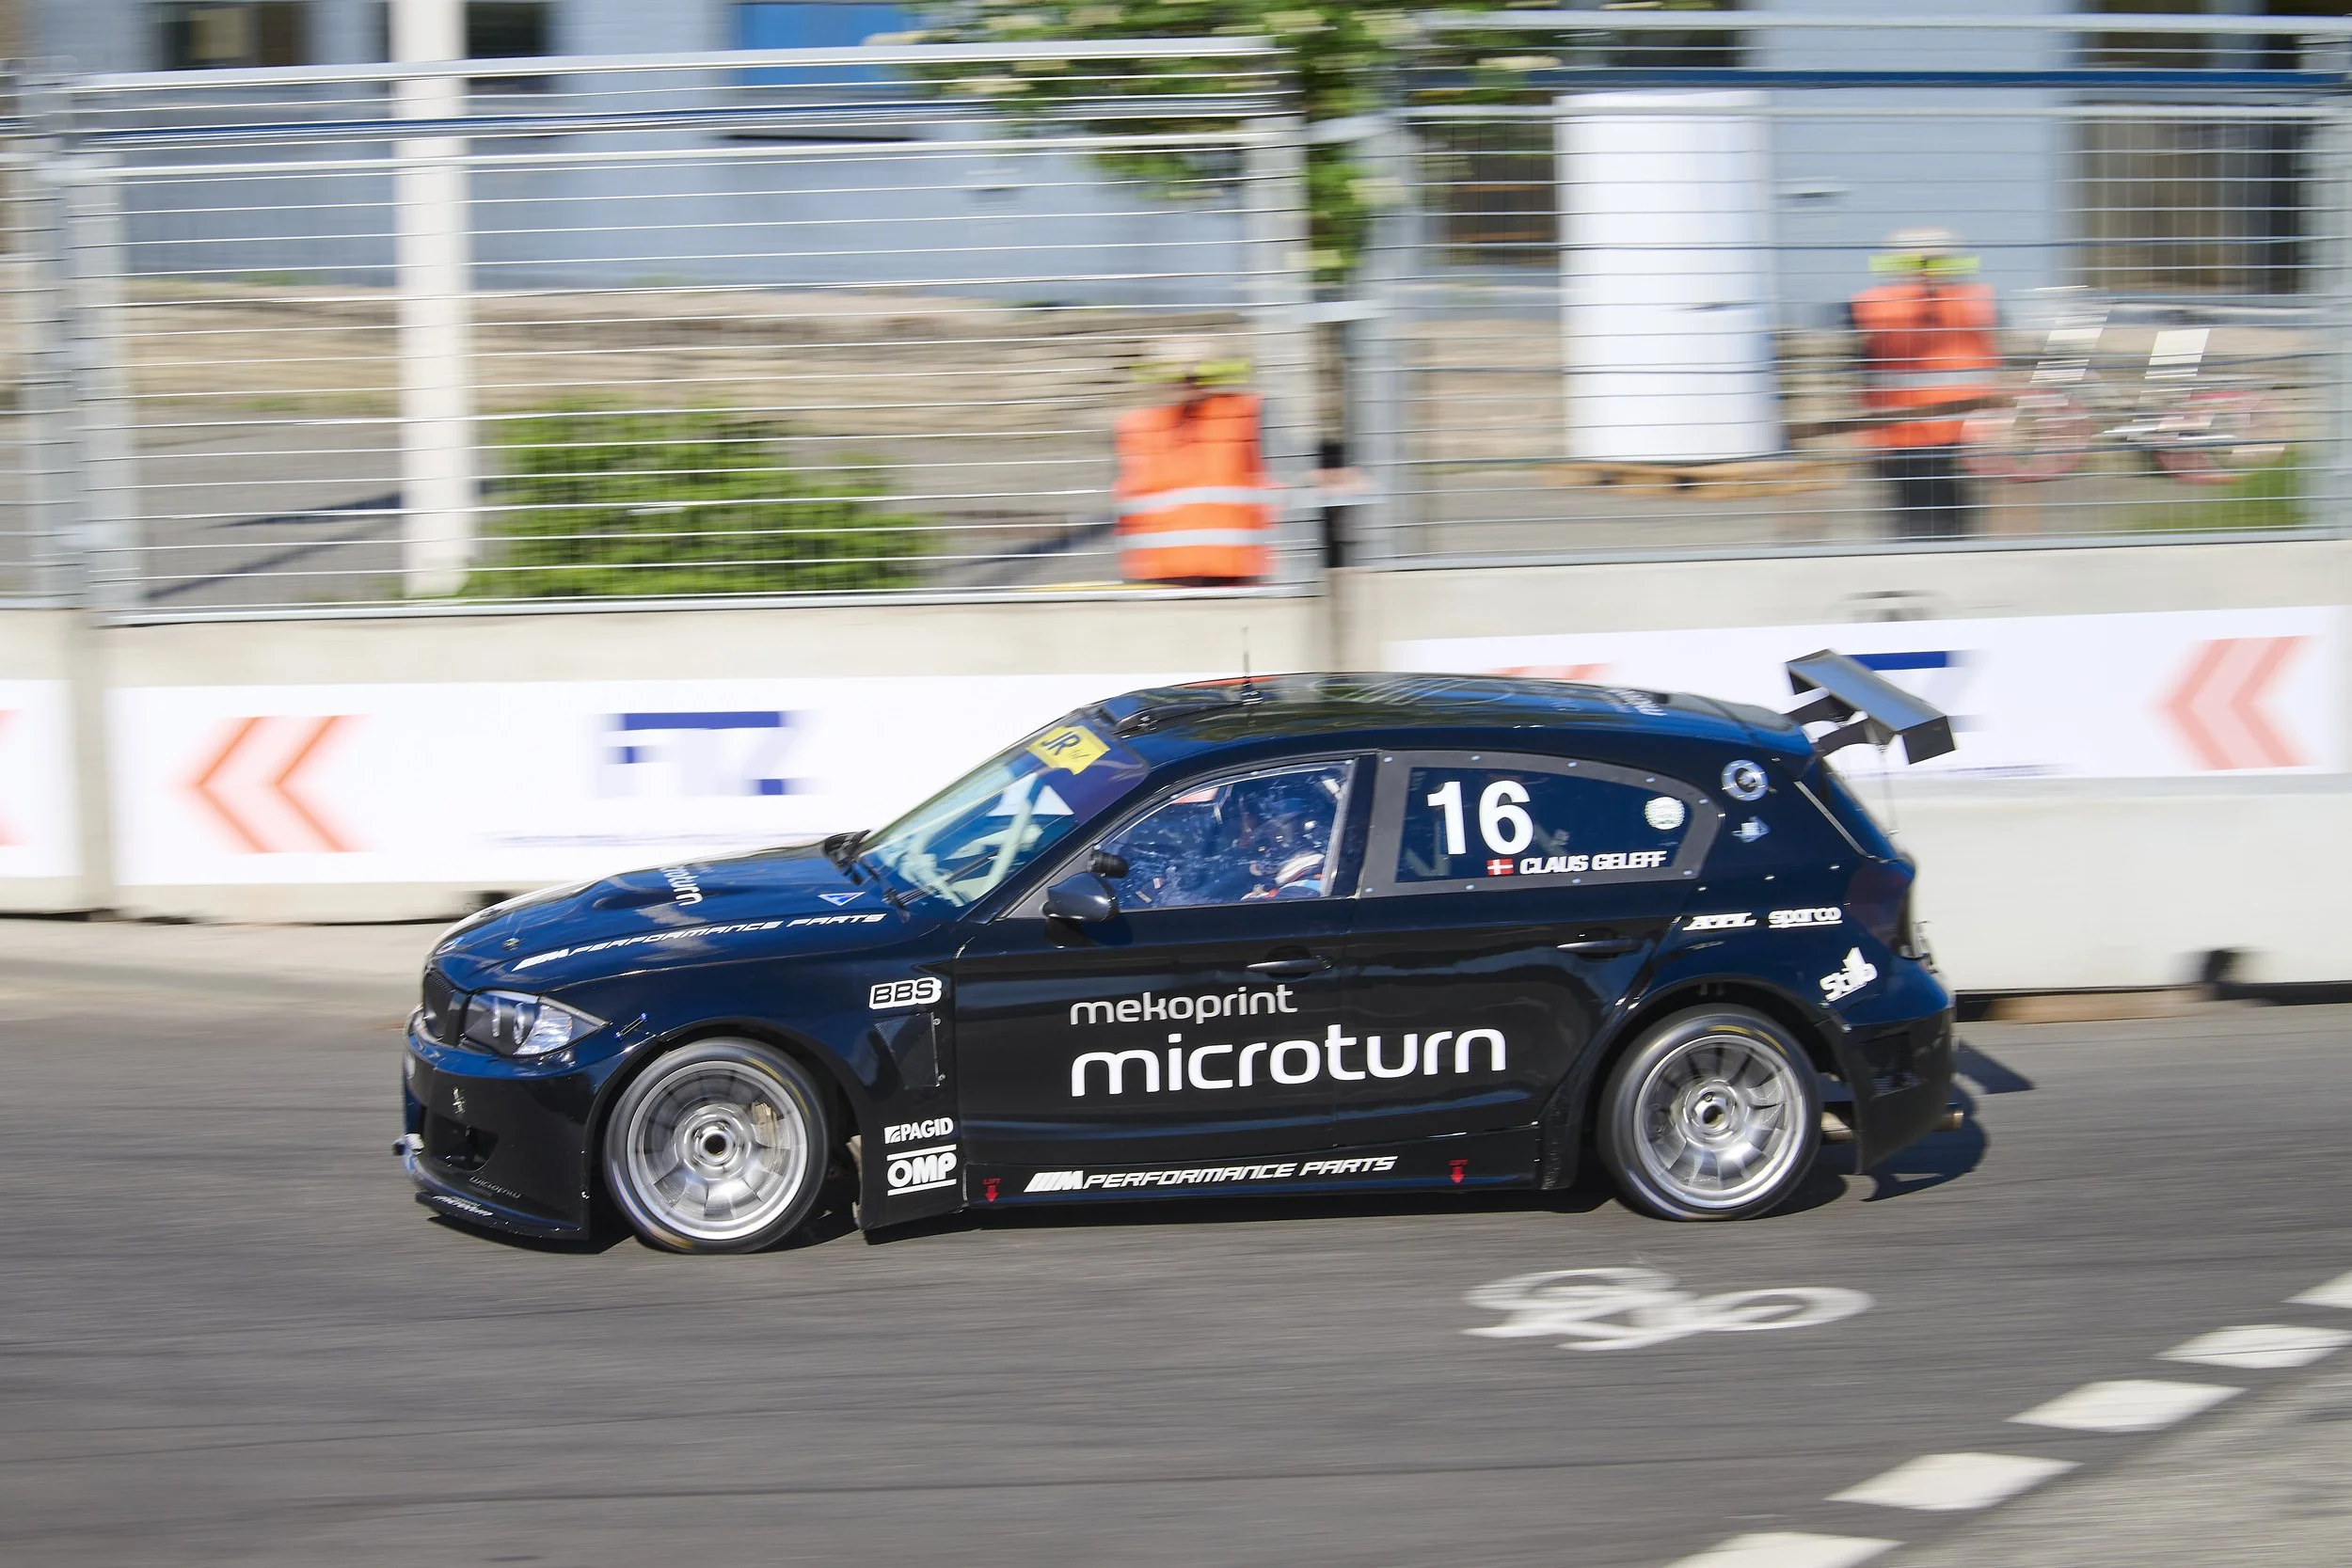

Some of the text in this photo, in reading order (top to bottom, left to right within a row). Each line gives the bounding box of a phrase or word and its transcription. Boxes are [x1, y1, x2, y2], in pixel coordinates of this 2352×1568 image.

[1427, 780, 1534, 855] 16
[1519, 850, 1668, 875] CLAUS GELEFF
[787, 913, 887, 927] PARTS
[1768, 907, 1843, 929] sparco
[871, 978, 938, 1006] BBS
[1070, 984, 1298, 1025] mekoprint
[1071, 1023, 1507, 1098] microturn
[900, 1117, 954, 1142] PAGID
[887, 1151, 958, 1188] OMP
[1082, 1162, 1298, 1190] PERFORMANCE
[1298, 1155, 1399, 1177] PARTS
